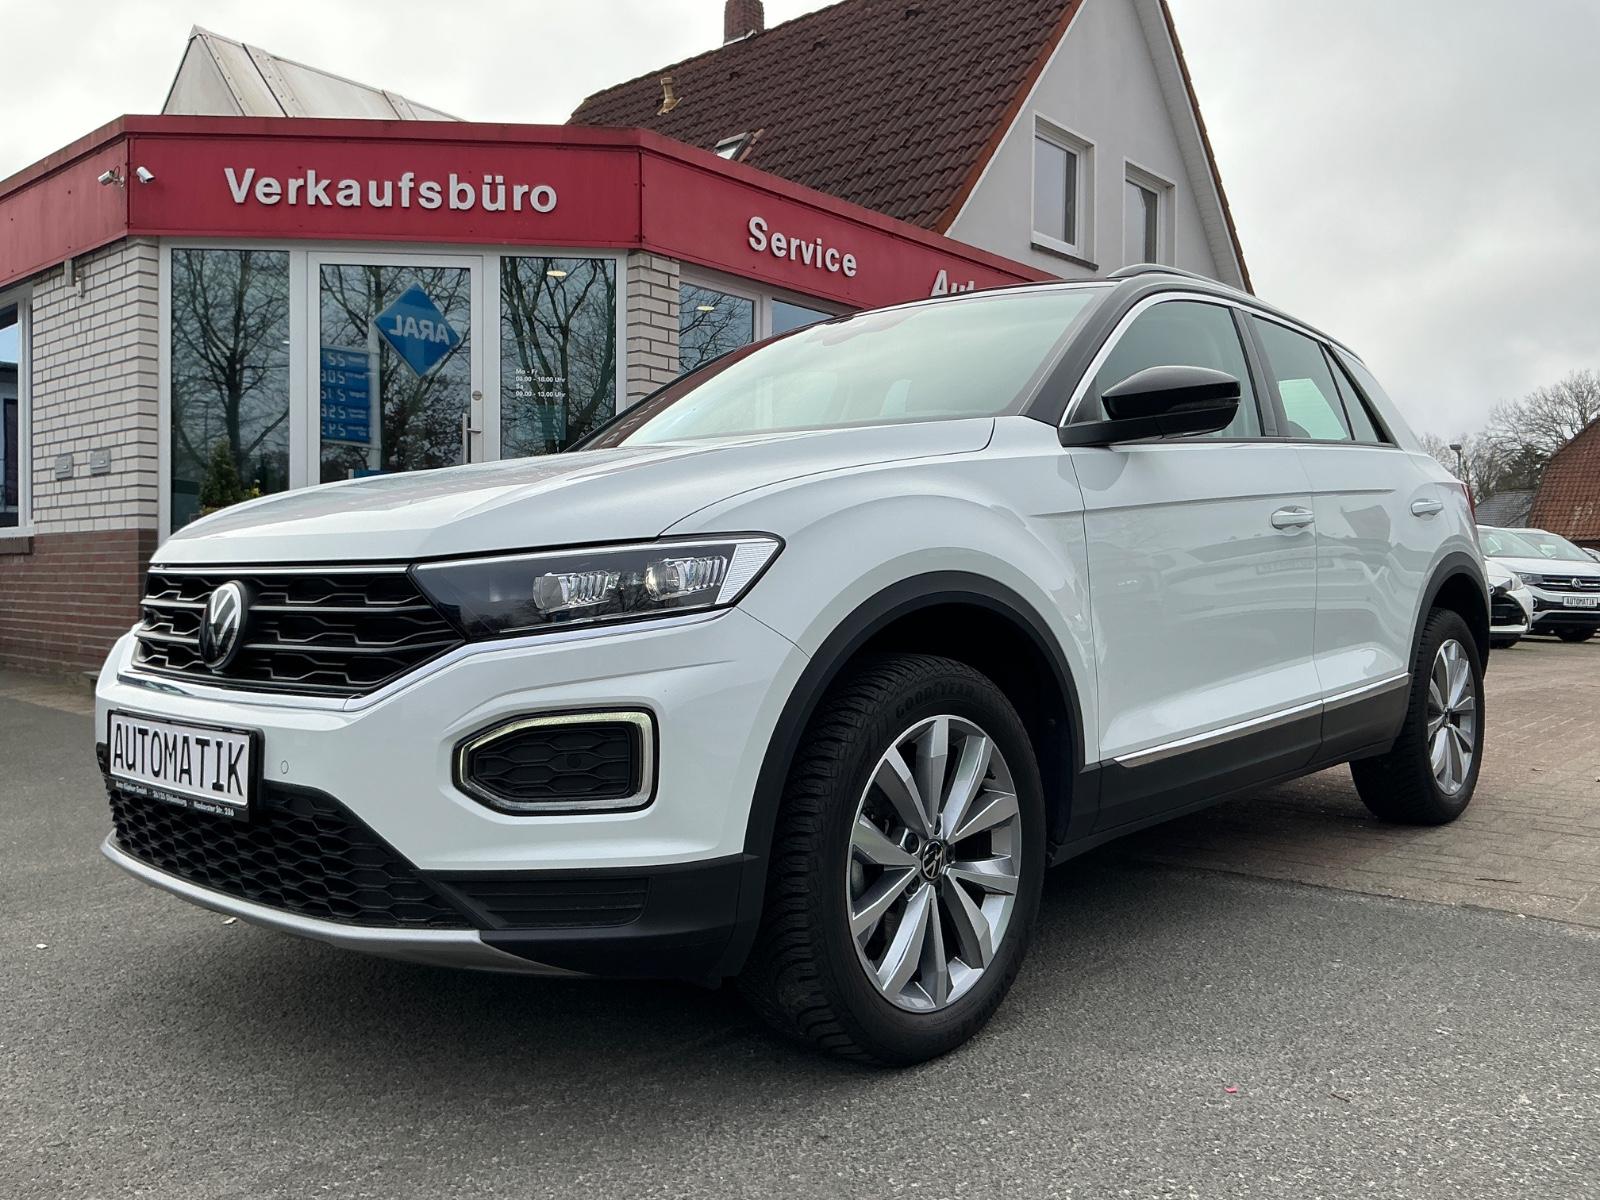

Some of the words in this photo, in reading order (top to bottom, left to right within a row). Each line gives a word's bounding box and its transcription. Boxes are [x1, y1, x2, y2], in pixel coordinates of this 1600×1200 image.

[224, 167, 557, 213] Verkaufsbüro
[748, 216, 857, 277] Service
[113, 723, 245, 796] AUTOMATIK
